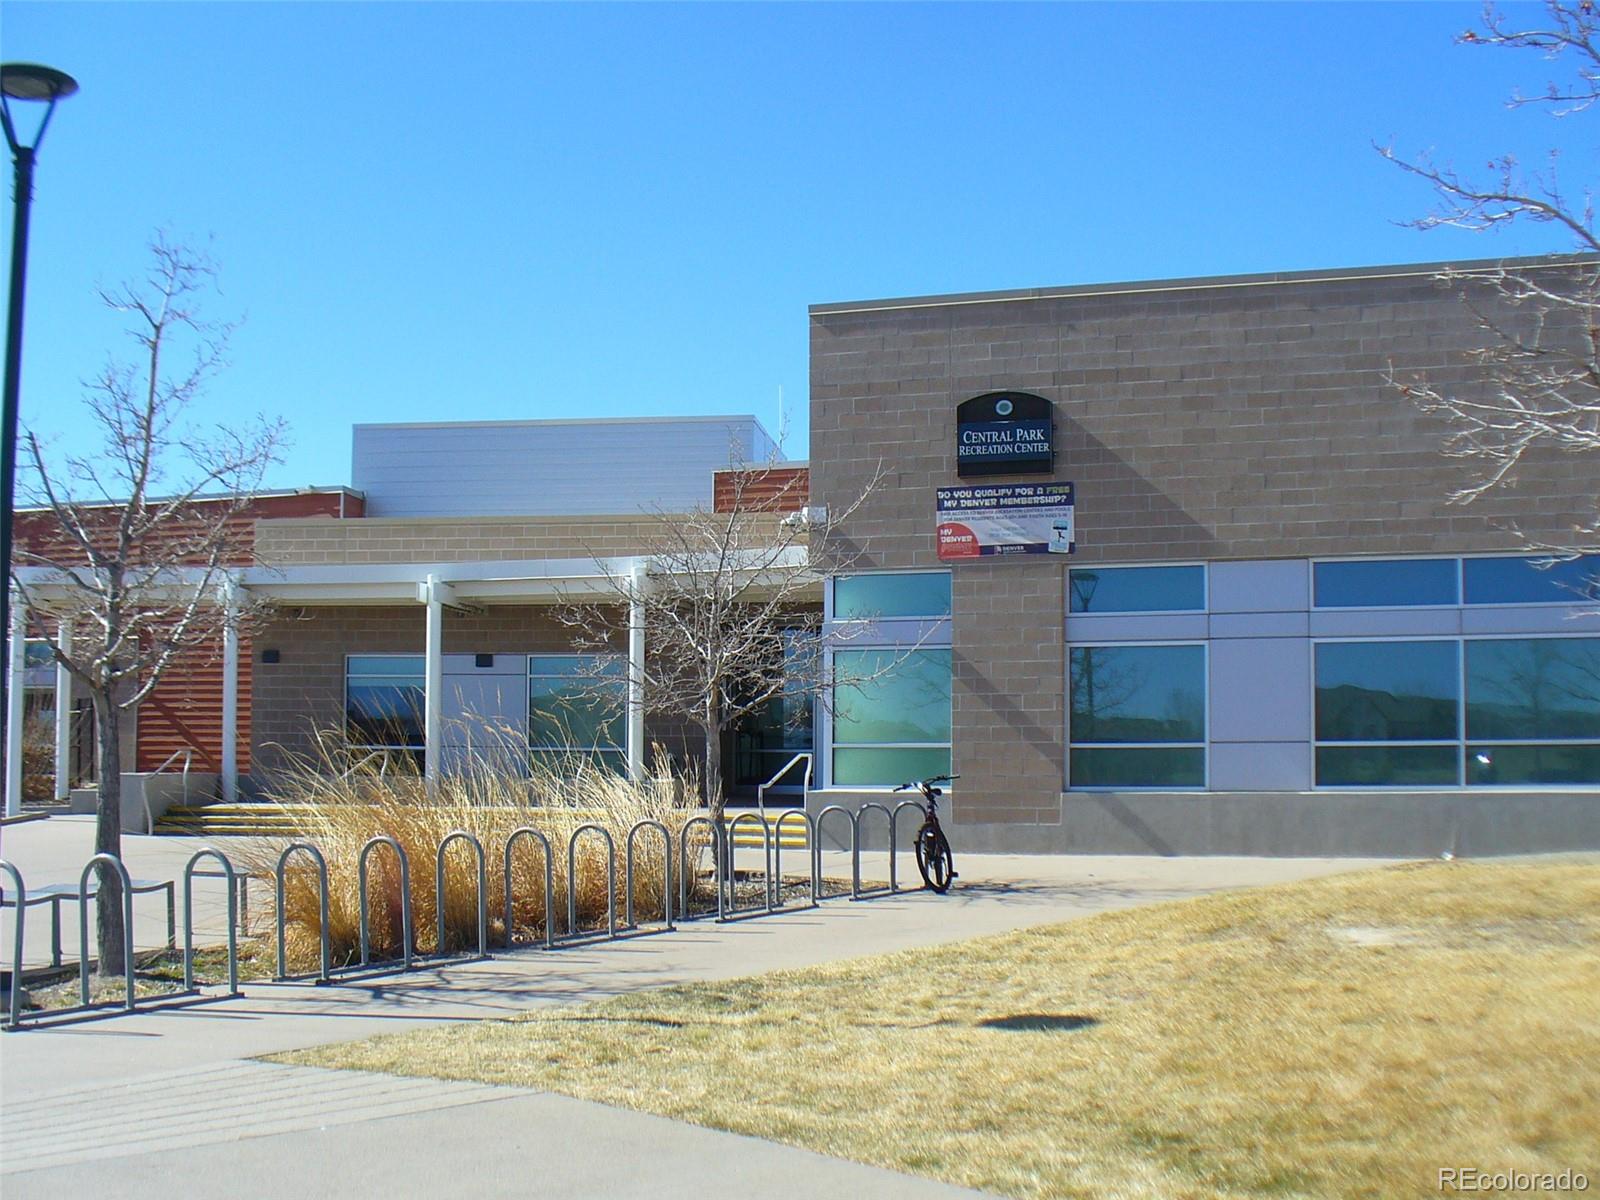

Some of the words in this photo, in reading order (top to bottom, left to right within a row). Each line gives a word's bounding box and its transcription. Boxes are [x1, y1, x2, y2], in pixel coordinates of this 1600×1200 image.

[963, 430, 1013, 444] CENTRAL
[1016, 428, 1045, 441] PARK
[959, 444, 1013, 456] RECREATION
[1014, 442, 1050, 454] CENTER
[937, 491, 951, 499] DO
[953, 490, 972, 498] YOU
[974, 487, 1012, 497] QUALIFY
[1015, 487, 1034, 496] FOR
[1036, 486, 1044, 495] A
[1046, 485, 1070, 494] FREE
[943, 500, 958, 508] MY
[960, 498, 997, 507] DENVER
[1000, 495, 1067, 505] MEMBERSHIP?
